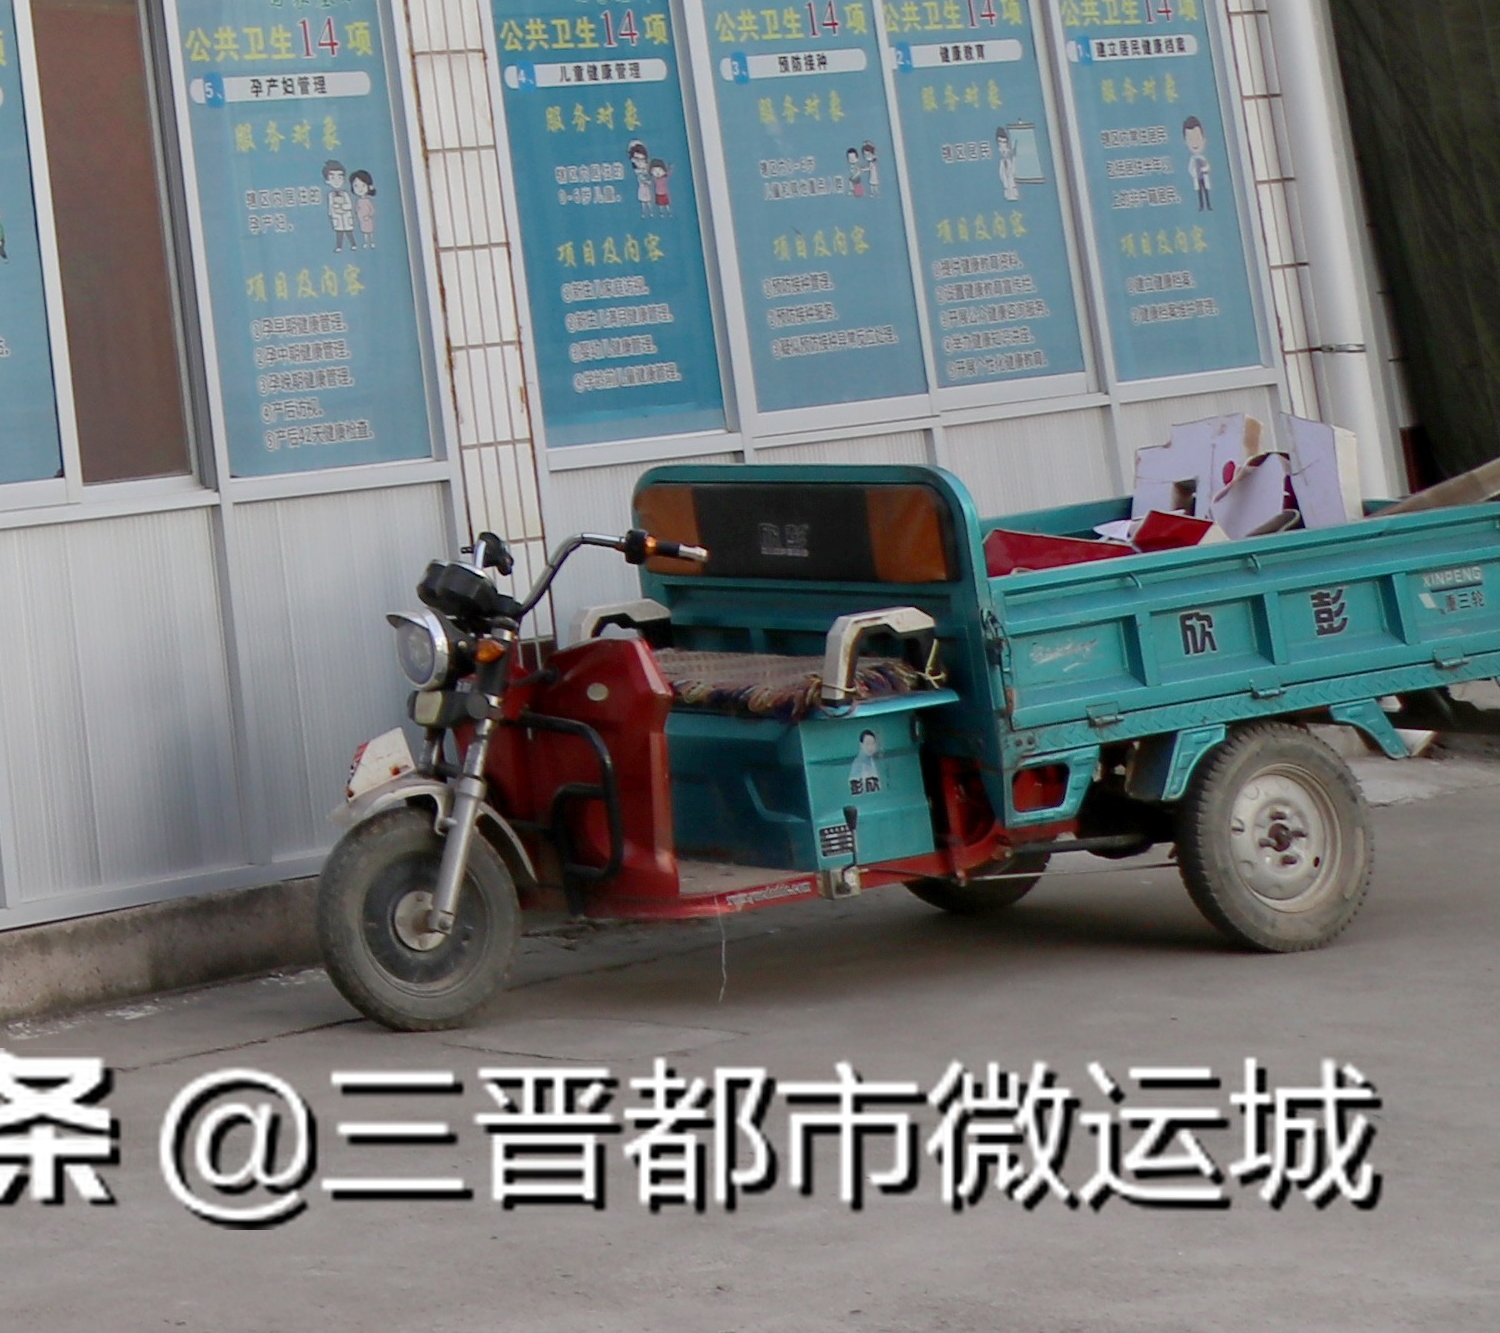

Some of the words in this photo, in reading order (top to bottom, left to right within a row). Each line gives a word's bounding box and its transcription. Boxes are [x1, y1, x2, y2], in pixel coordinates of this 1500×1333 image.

[501, 9, 669, 51] 公共卫生14项
[715, 0, 868, 43] 公共卫生14项
[186, 18, 372, 63] 公共卫生14项
[940, 44, 985, 63] 健康教育
[1096, 37, 1186, 58] 建立居民健康档案
[560, 64, 641, 82] 儿童健康管理
[779, 54, 827, 72] 预防接种
[250, 77, 327, 97] 孕产妇管理
[546, 99, 642, 133] 服务对象
[235, 116, 341, 152] 服务对象
[557, 234, 665, 268] 项目及内容
[246, 266, 366, 301] 项目及内容
[1422, 566, 1482, 588] XINPENG
